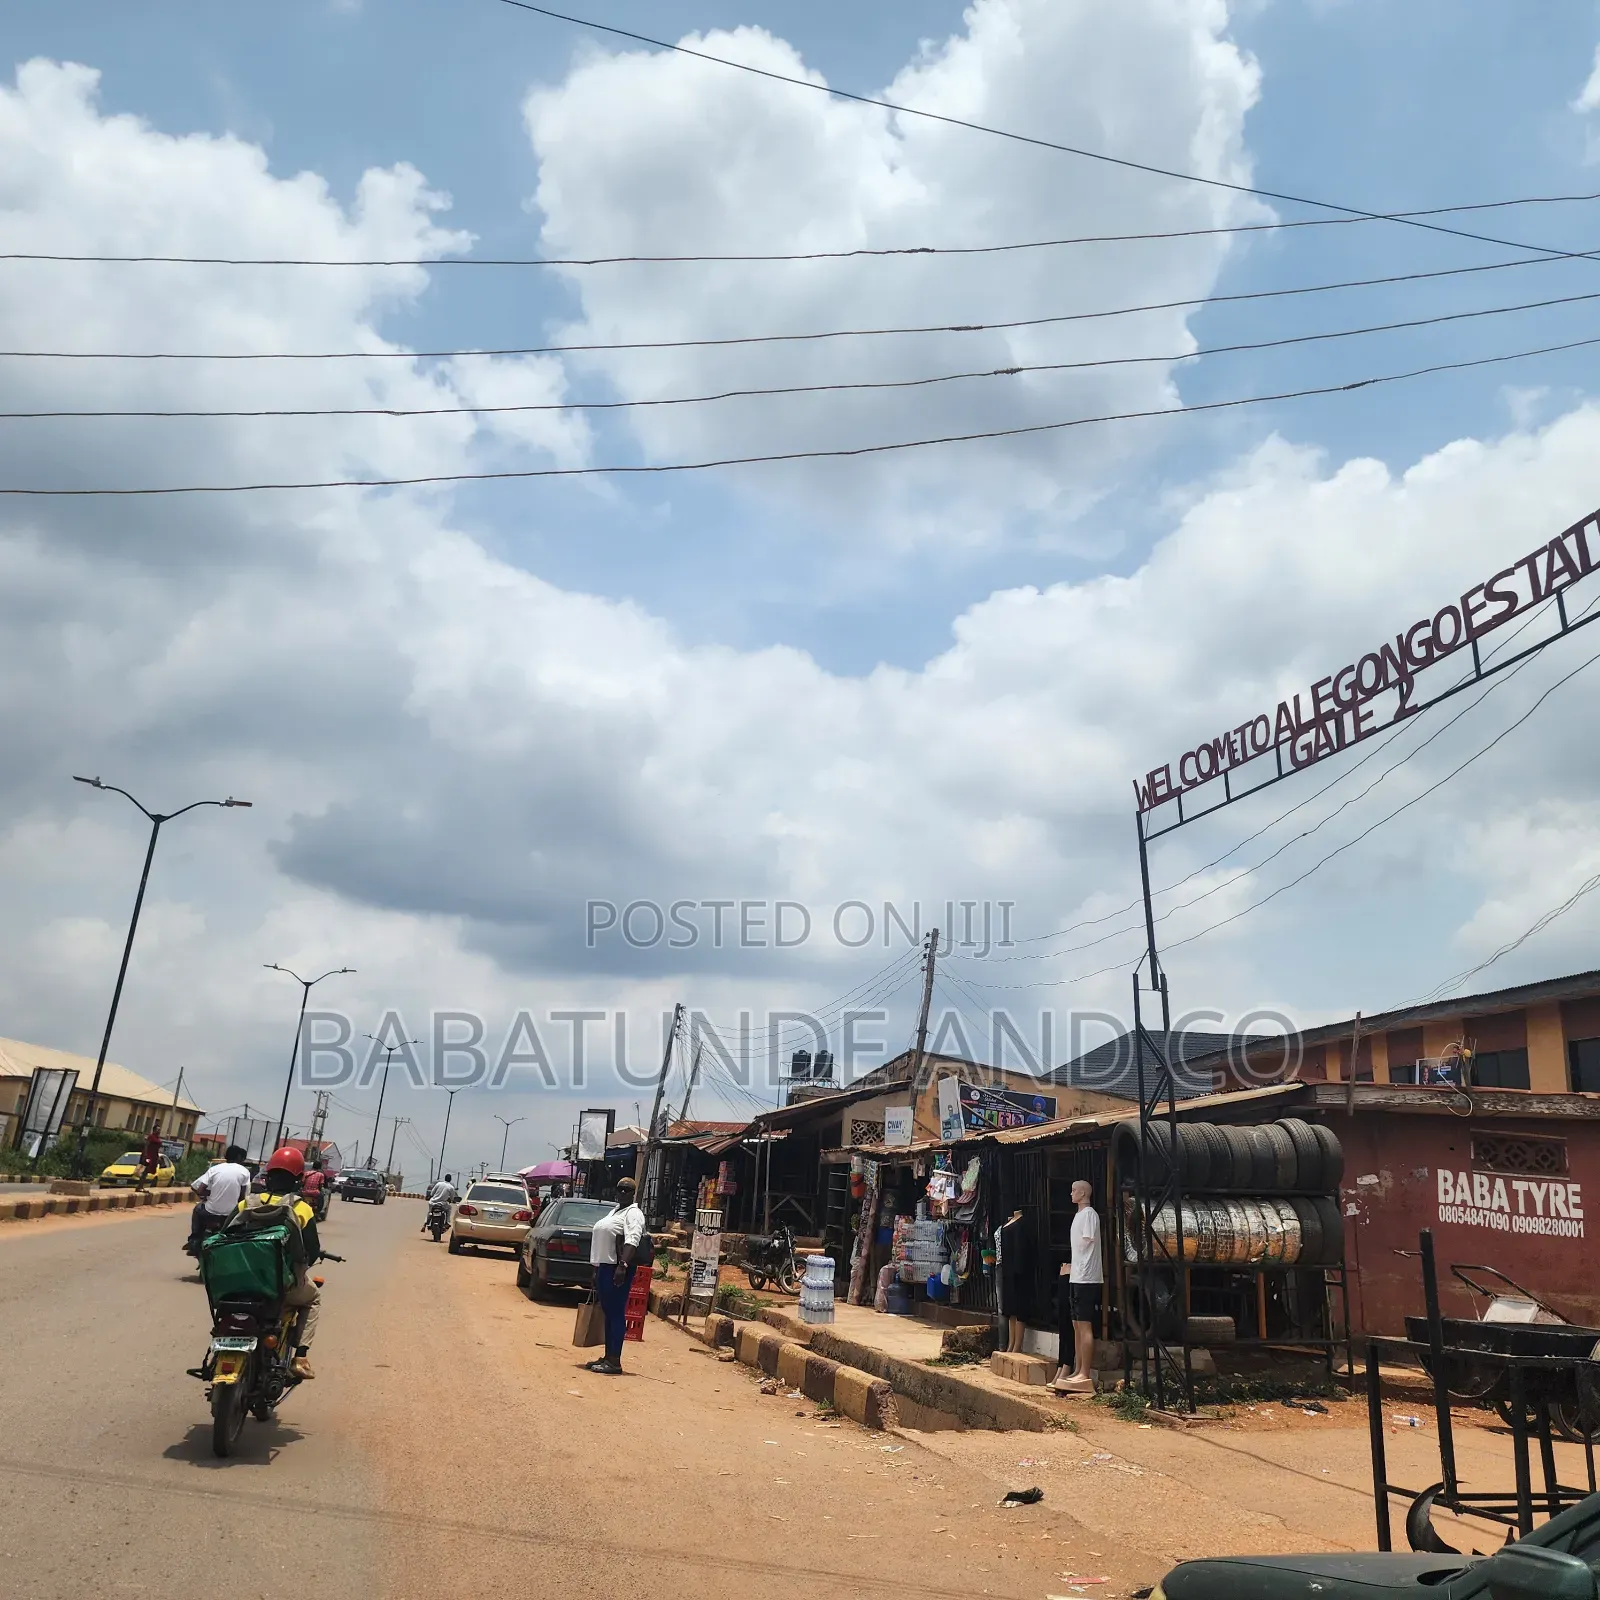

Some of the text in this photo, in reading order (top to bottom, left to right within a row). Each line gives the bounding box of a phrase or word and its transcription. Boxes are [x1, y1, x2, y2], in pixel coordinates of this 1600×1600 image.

[1289, 673, 1419, 770] GATE 2
[887, 1120, 902, 1130] CWAY
[1437, 1168, 1584, 1219] BABA TYRE
[1512, 1214, 1585, 1238] 09098280001
